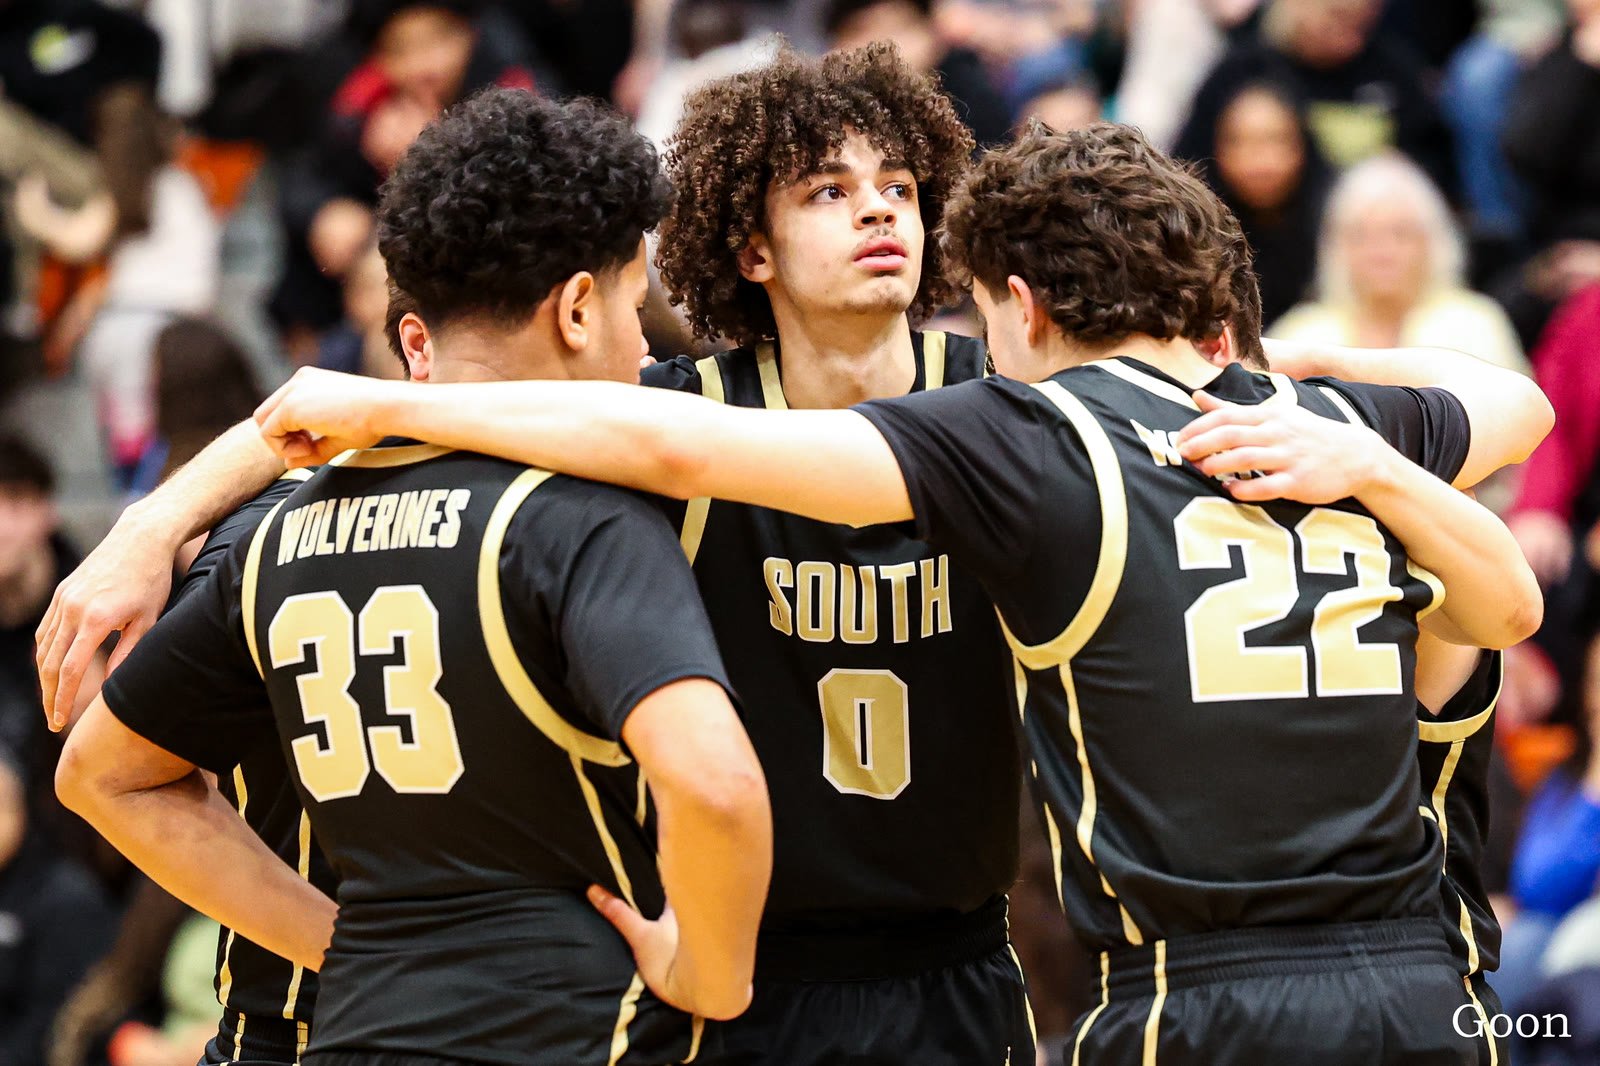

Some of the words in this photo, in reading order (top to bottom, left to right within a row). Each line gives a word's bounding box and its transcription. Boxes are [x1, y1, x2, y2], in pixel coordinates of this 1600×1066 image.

[277, 489, 471, 566] WOLVERINES
[763, 554, 952, 645] SOUTH
[1173, 496, 1404, 703] 22
[268, 584, 465, 803] 33
[817, 667, 911, 800] 0
